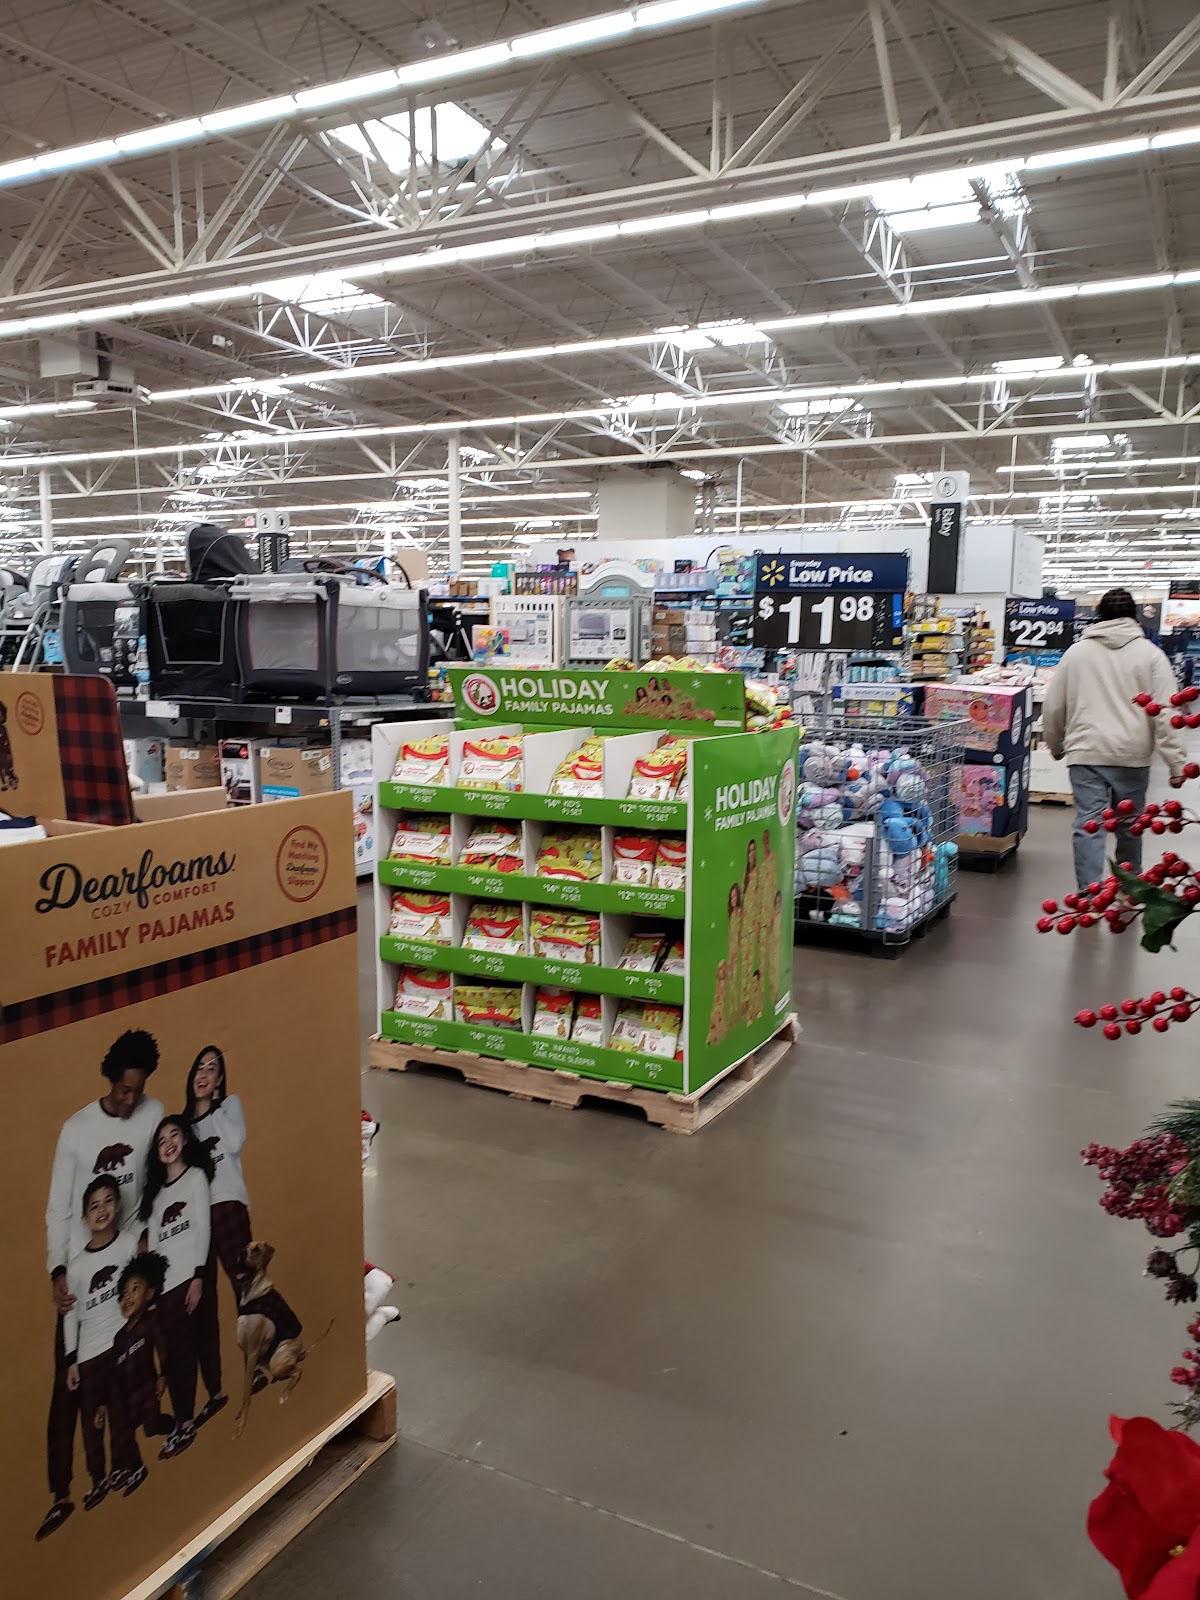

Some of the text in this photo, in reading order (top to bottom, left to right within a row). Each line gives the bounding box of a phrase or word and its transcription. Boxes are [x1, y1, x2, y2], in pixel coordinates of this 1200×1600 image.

[938, 507, 955, 537] Baby
[790, 560, 822, 568] Everyday
[789, 566, 874, 583] Low Price
[1019, 604, 1060, 615] Low Price
[501, 677, 611, 701] HOLIDAY
[504, 701, 614, 716] FAMILY PAJAMAS
[715, 775, 777, 812] HOLIDAY
[715, 812, 746, 832] FAMILY
[35, 848, 236, 914] Dearfoams
[91, 881, 217, 920] COZY COMFORT
[45, 901, 236, 968] FAMILY PAJAMAS
[213, 1153, 225, 1164] EAR
[116, 1172, 134, 1186] EAR
[170, 1220, 191, 1237] BEAR
[100, 1285, 119, 1303] BEA
